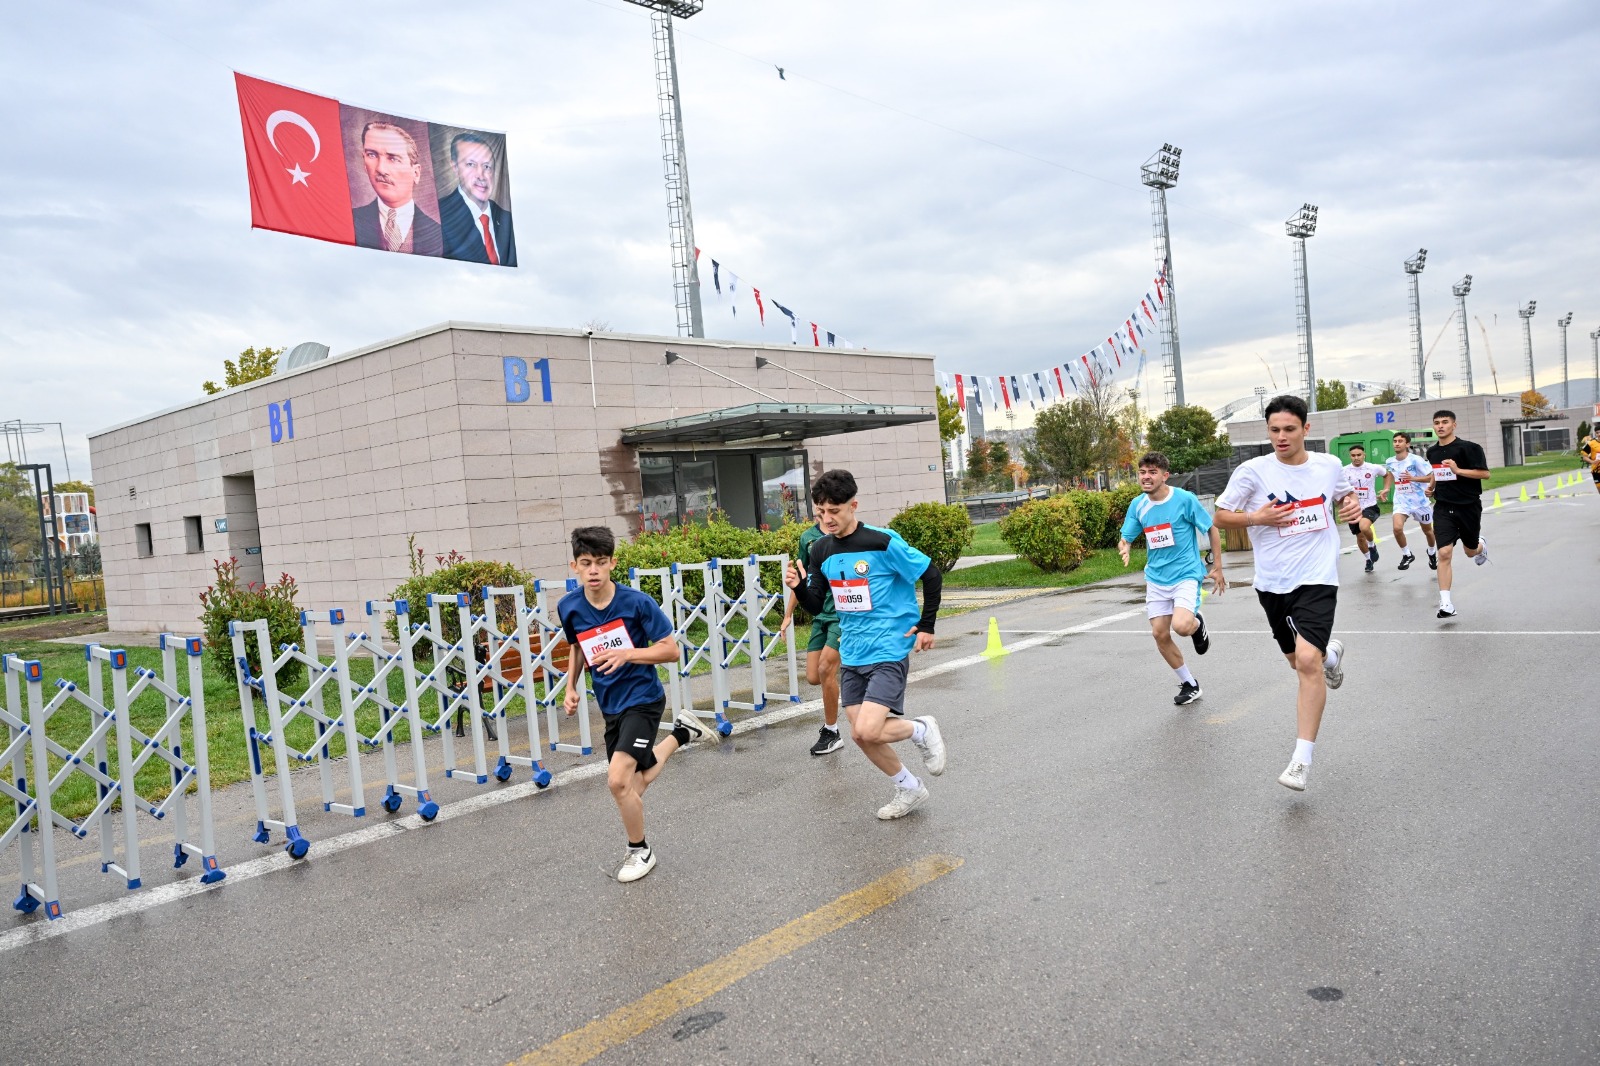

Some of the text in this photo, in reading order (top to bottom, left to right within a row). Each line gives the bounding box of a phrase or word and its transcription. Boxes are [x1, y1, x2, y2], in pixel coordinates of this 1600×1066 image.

[503, 356, 553, 403] B1
[268, 399, 294, 443] B1
[837, 594, 863, 604] 06059
[591, 637, 623, 655] 06246
